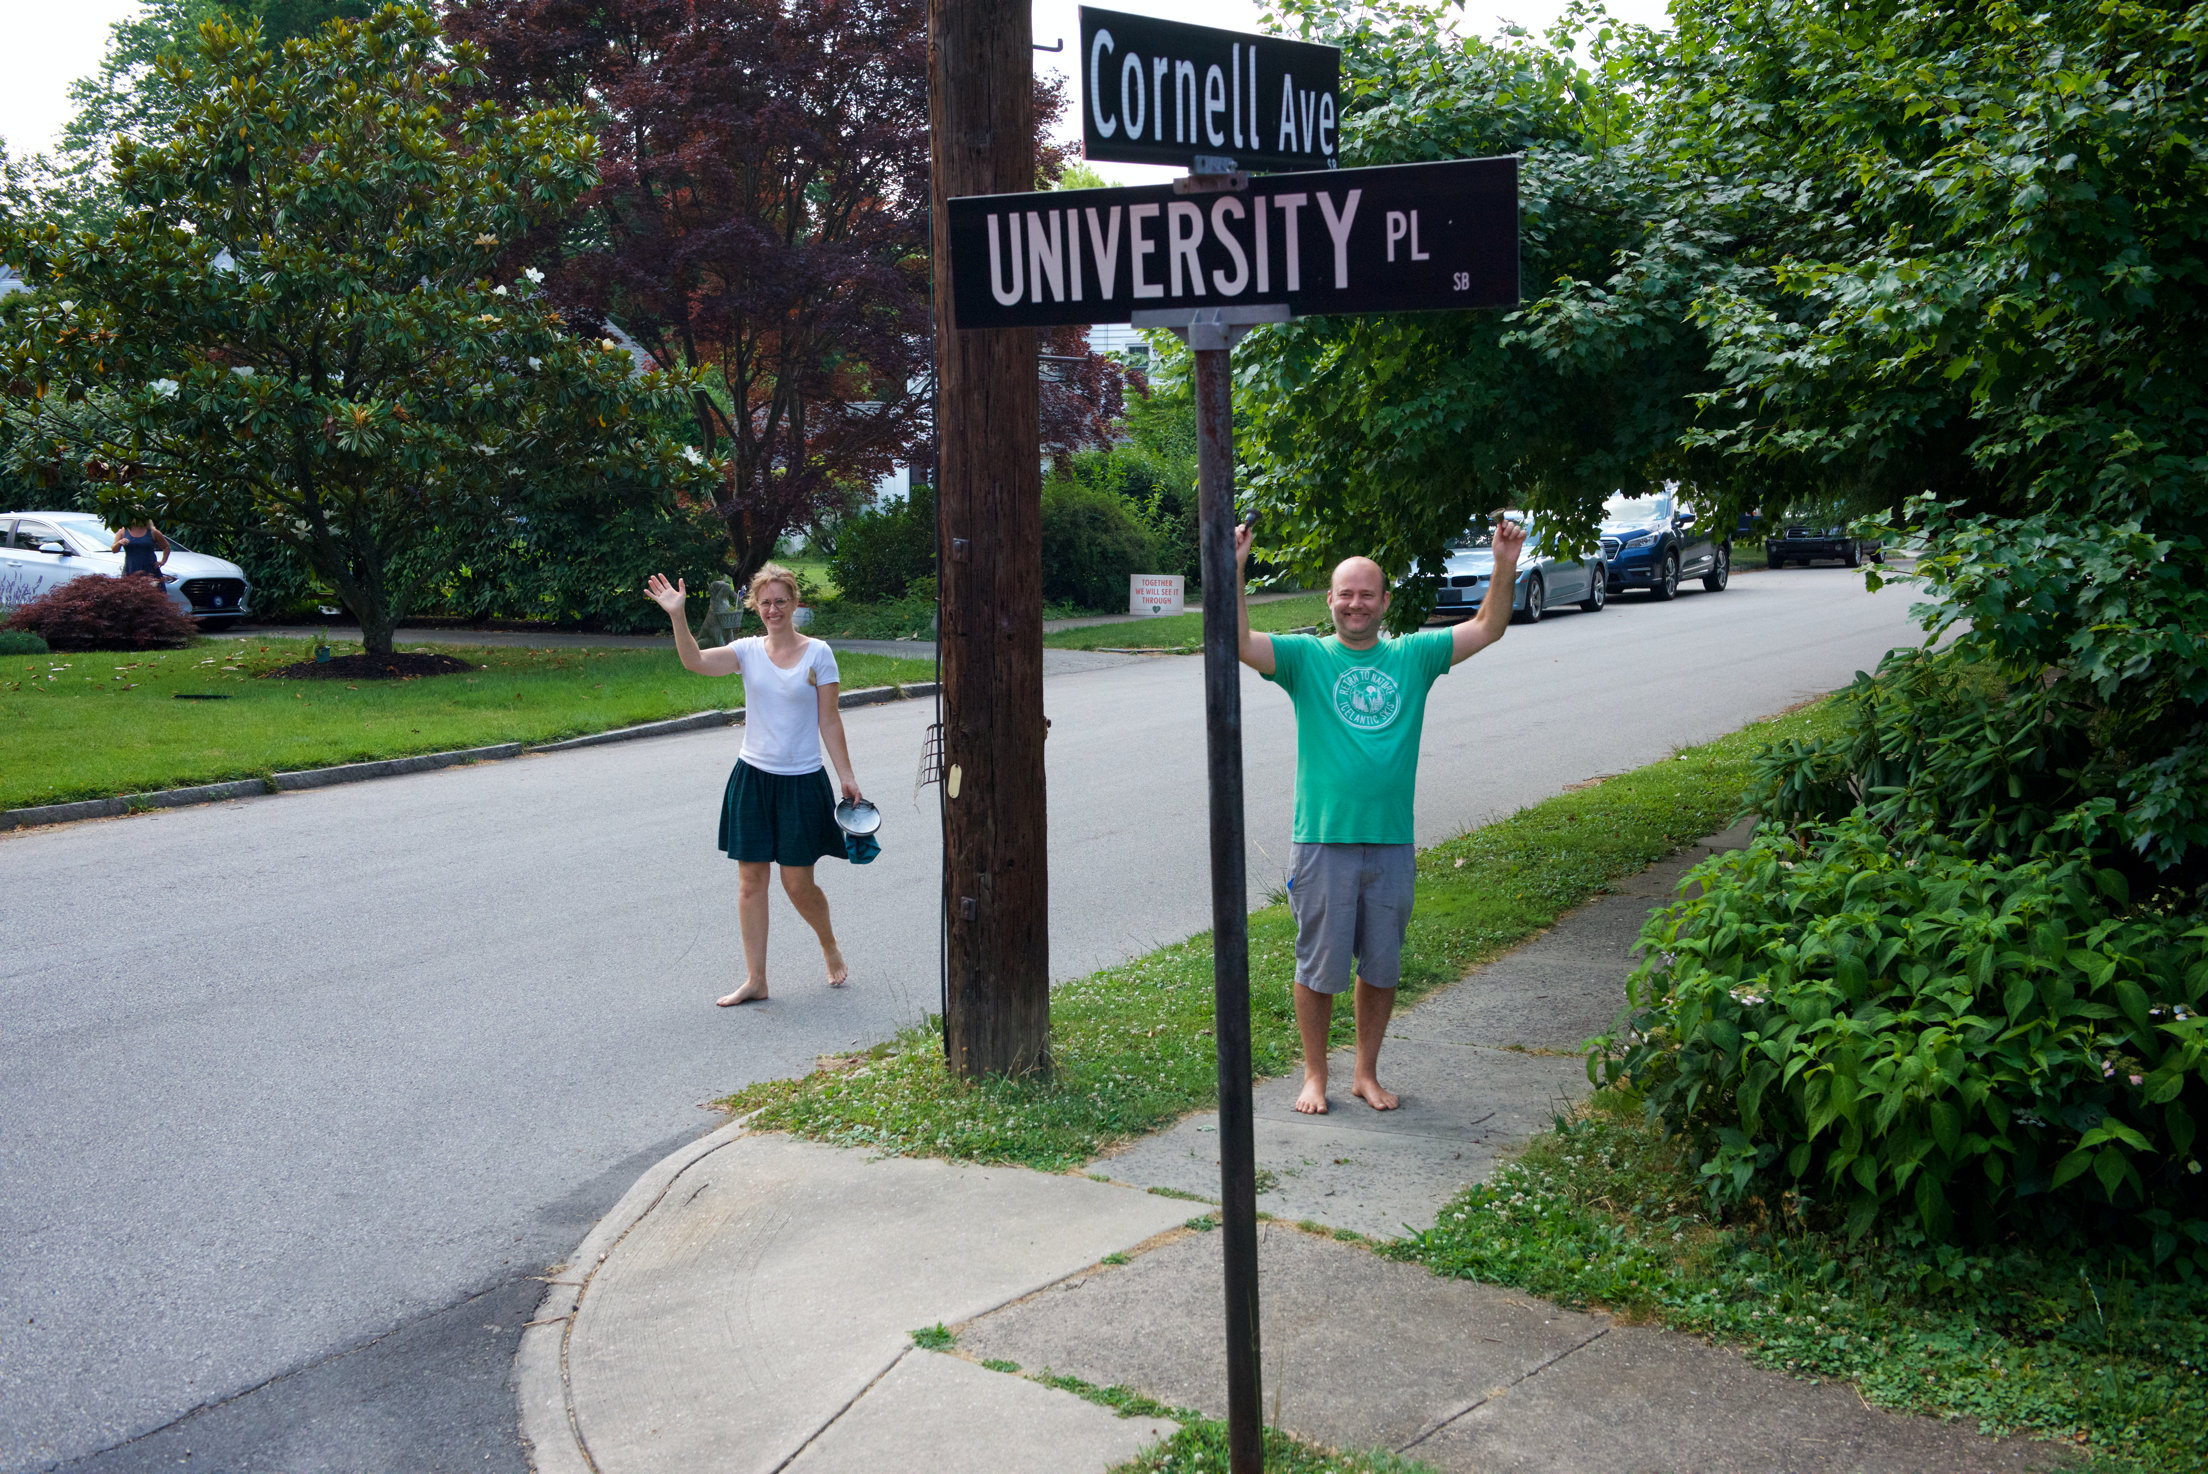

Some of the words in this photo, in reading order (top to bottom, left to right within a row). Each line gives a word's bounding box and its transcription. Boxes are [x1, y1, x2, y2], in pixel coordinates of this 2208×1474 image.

[1090, 28, 1260, 151] Cornell
[1278, 73, 1335, 155] Ave
[986, 189, 1363, 306] UNIVERSITY
[1386, 209, 1430, 262] PL
[1453, 271, 1470, 291] SB
[1142, 579, 1173, 587] TOGETHER
[1161, 588, 1172, 596] SEE
[1173, 588, 1179, 596] IT
[1142, 597, 1172, 605] THROUGH
[1338, 673, 1360, 696] RETRN
[1359, 670, 1370, 681] TO
[1370, 673, 1396, 696] NATURE
[1339, 701, 1380, 725] ICELANTIC
[1380, 701, 1395, 720] SKIS
